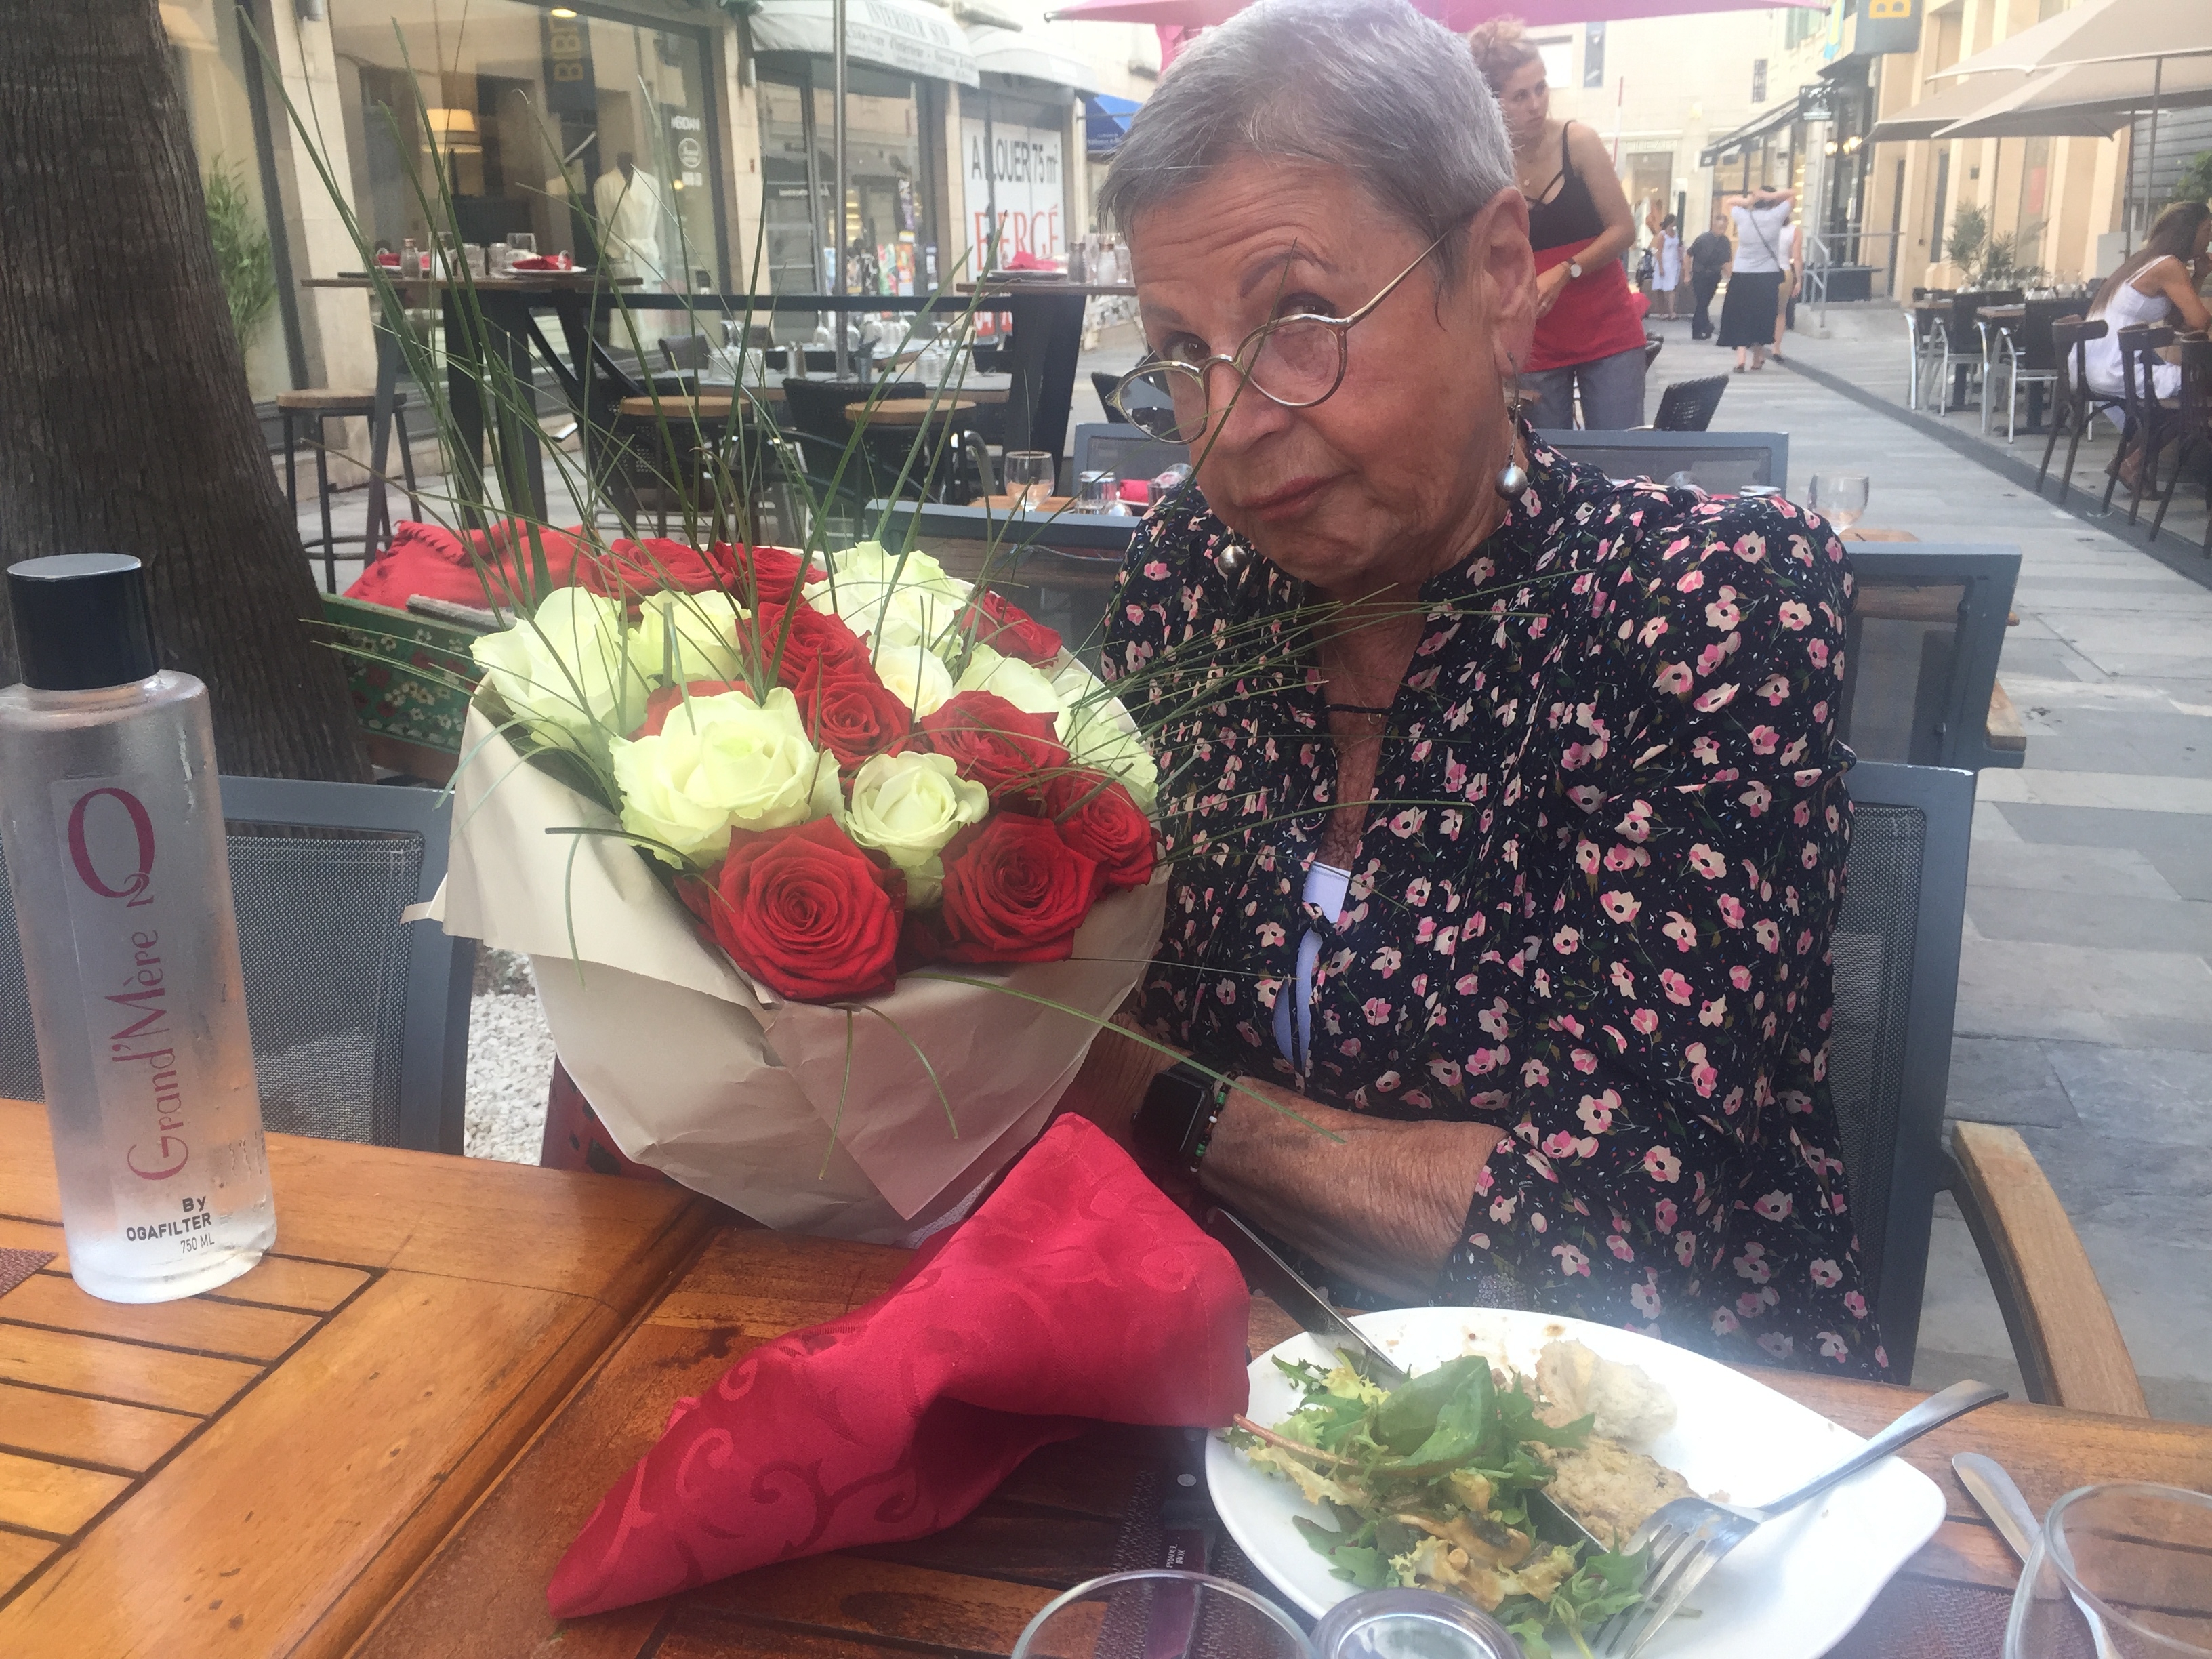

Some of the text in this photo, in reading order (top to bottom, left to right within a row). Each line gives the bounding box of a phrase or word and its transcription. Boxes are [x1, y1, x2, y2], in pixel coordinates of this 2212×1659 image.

[972, 135, 982, 179] A
[1032, 143, 1044, 184] 75
[104, 930, 189, 1181] Grand'Mère
[126, 1212, 212, 1242] OGAFILTER
[180, 1231, 215, 1254] 750 ML
